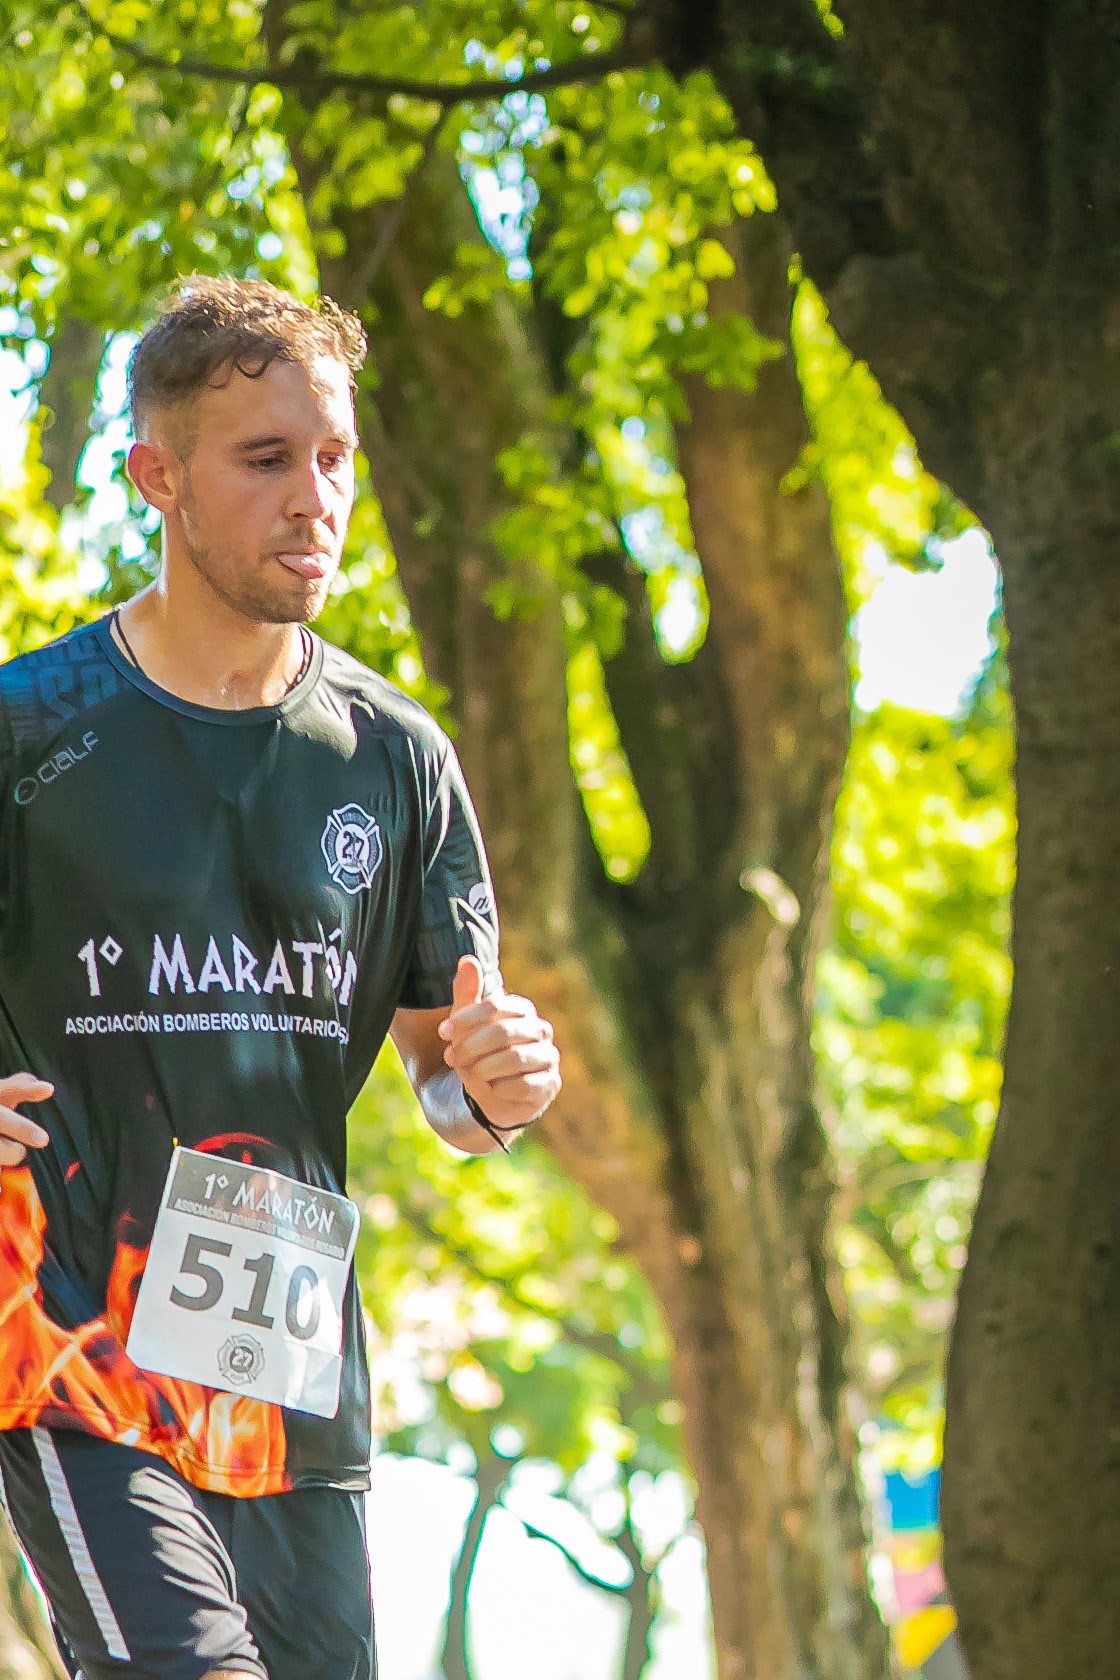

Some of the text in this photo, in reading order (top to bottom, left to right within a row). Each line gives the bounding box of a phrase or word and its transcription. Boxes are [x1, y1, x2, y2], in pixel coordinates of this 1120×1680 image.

[65, 1010, 160, 1035] ASOCIACIÓN
[164, 1012, 250, 1033] BOMBEROS
[232, 1181, 336, 1235] MARATÓN
[169, 1233, 321, 1341] 510
